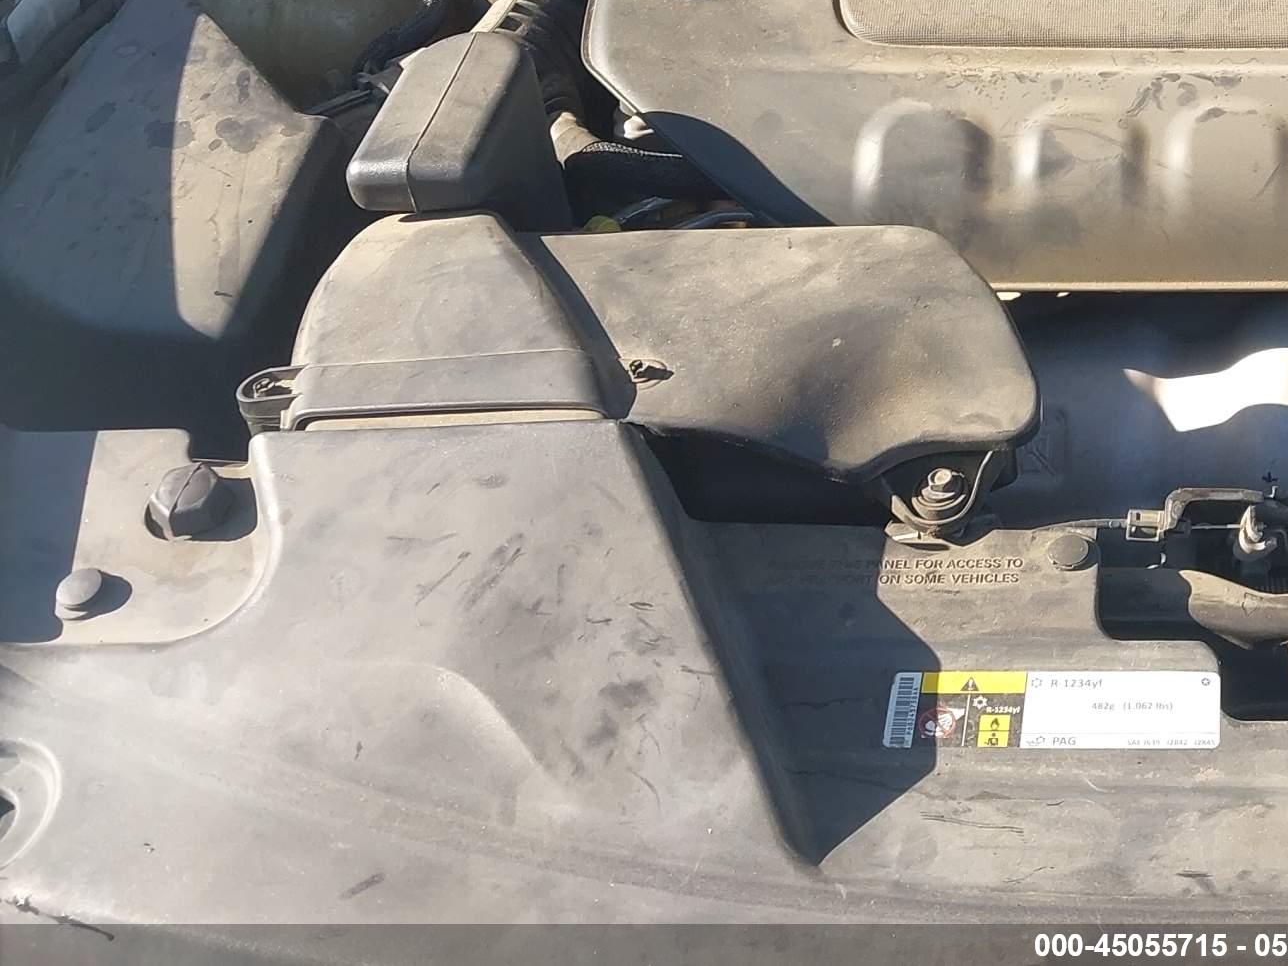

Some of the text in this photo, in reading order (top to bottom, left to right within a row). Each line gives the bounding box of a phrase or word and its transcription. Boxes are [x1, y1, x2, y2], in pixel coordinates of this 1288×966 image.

[866, 559, 910, 570] PANEL
[915, 558, 943, 570] FOR
[946, 558, 1001, 569] ACCESS
[1006, 557, 1024, 569] TO
[879, 573, 900, 585] ON
[904, 573, 946, 585] SOME
[951, 572, 1020, 584] VEHICLES
[986, 705, 1021, 715] R-1234yf
[1091, 702, 1115, 712] 482g
[1155, 701, 1174, 712] lbs)
[1052, 736, 1077, 747] PAG
